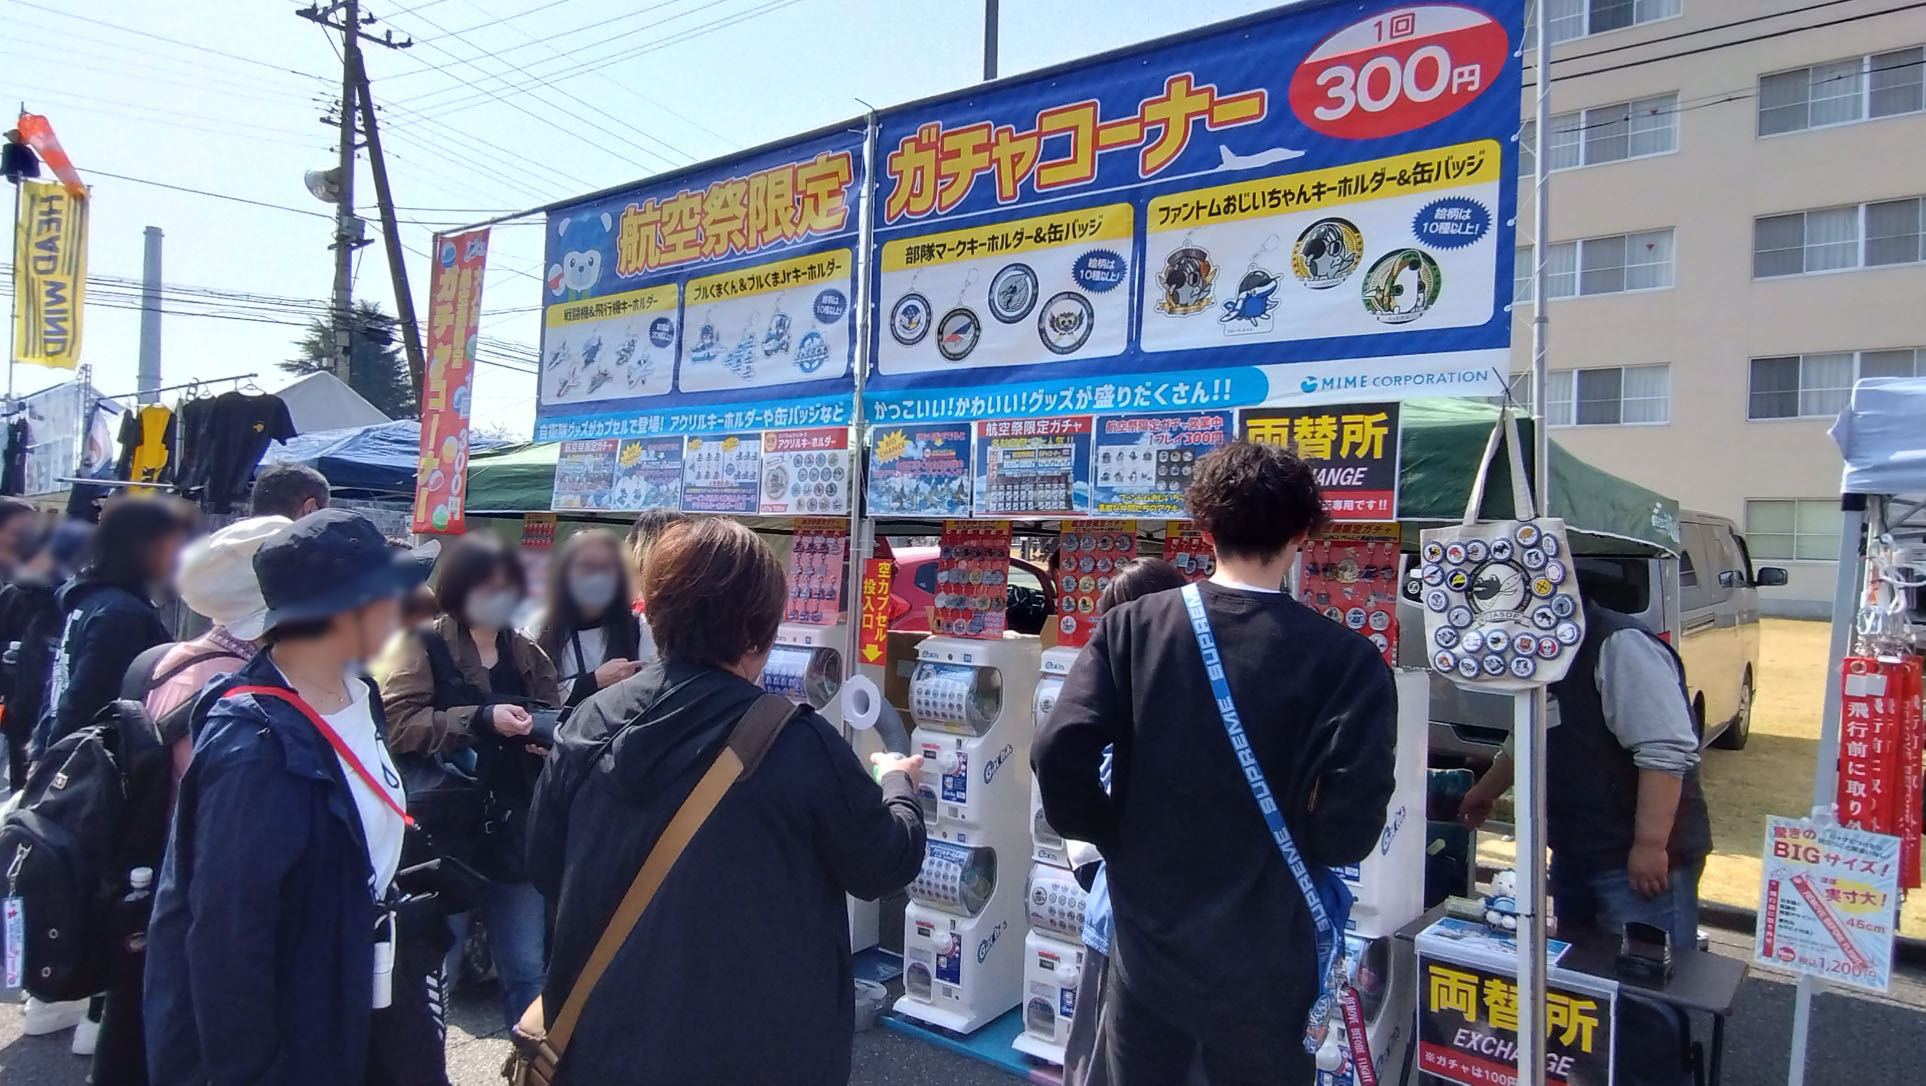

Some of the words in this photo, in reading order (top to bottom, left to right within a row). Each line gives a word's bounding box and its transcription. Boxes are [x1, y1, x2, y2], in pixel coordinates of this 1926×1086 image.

[1374, 13, 1415, 41] 1回
[1314, 45, 1480, 120] 300円
[884, 72, 1269, 224] ガチャコーナー
[1159, 150, 1486, 225] ファントムおじいちゃんキーホルダー&缶バッジ
[616, 151, 853, 279] 航空祭限定
[1434, 207, 1472, 221] 絵柄は
[905, 215, 1104, 265] 部隊マークキーホルダー&缶バッジ
[1087, 257, 1116, 271] 絵柄は
[416, 264, 459, 523] ガチャコーナー
[1321, 375, 1368, 391] MIME
[1372, 370, 1489, 387] CORPORATION
[669, 401, 845, 432] アクリルキーホルダーや缶バッジなど
[985, 419, 1083, 437] 航空祭限定ガチャ
[1246, 412, 1389, 460] 両替所
[447, 428, 468, 520] 300円
[862, 578, 876, 629] 投入口
[874, 561, 892, 642] 空カプセル
[1216, 694, 1278, 815] SUPREME
[1272, 826, 1331, 933] SUPREME
[1825, 887, 1888, 907] 実寸大!
[1428, 964, 1599, 1054] 両替所
[1350, 1026, 1364, 1055] BEFORE
